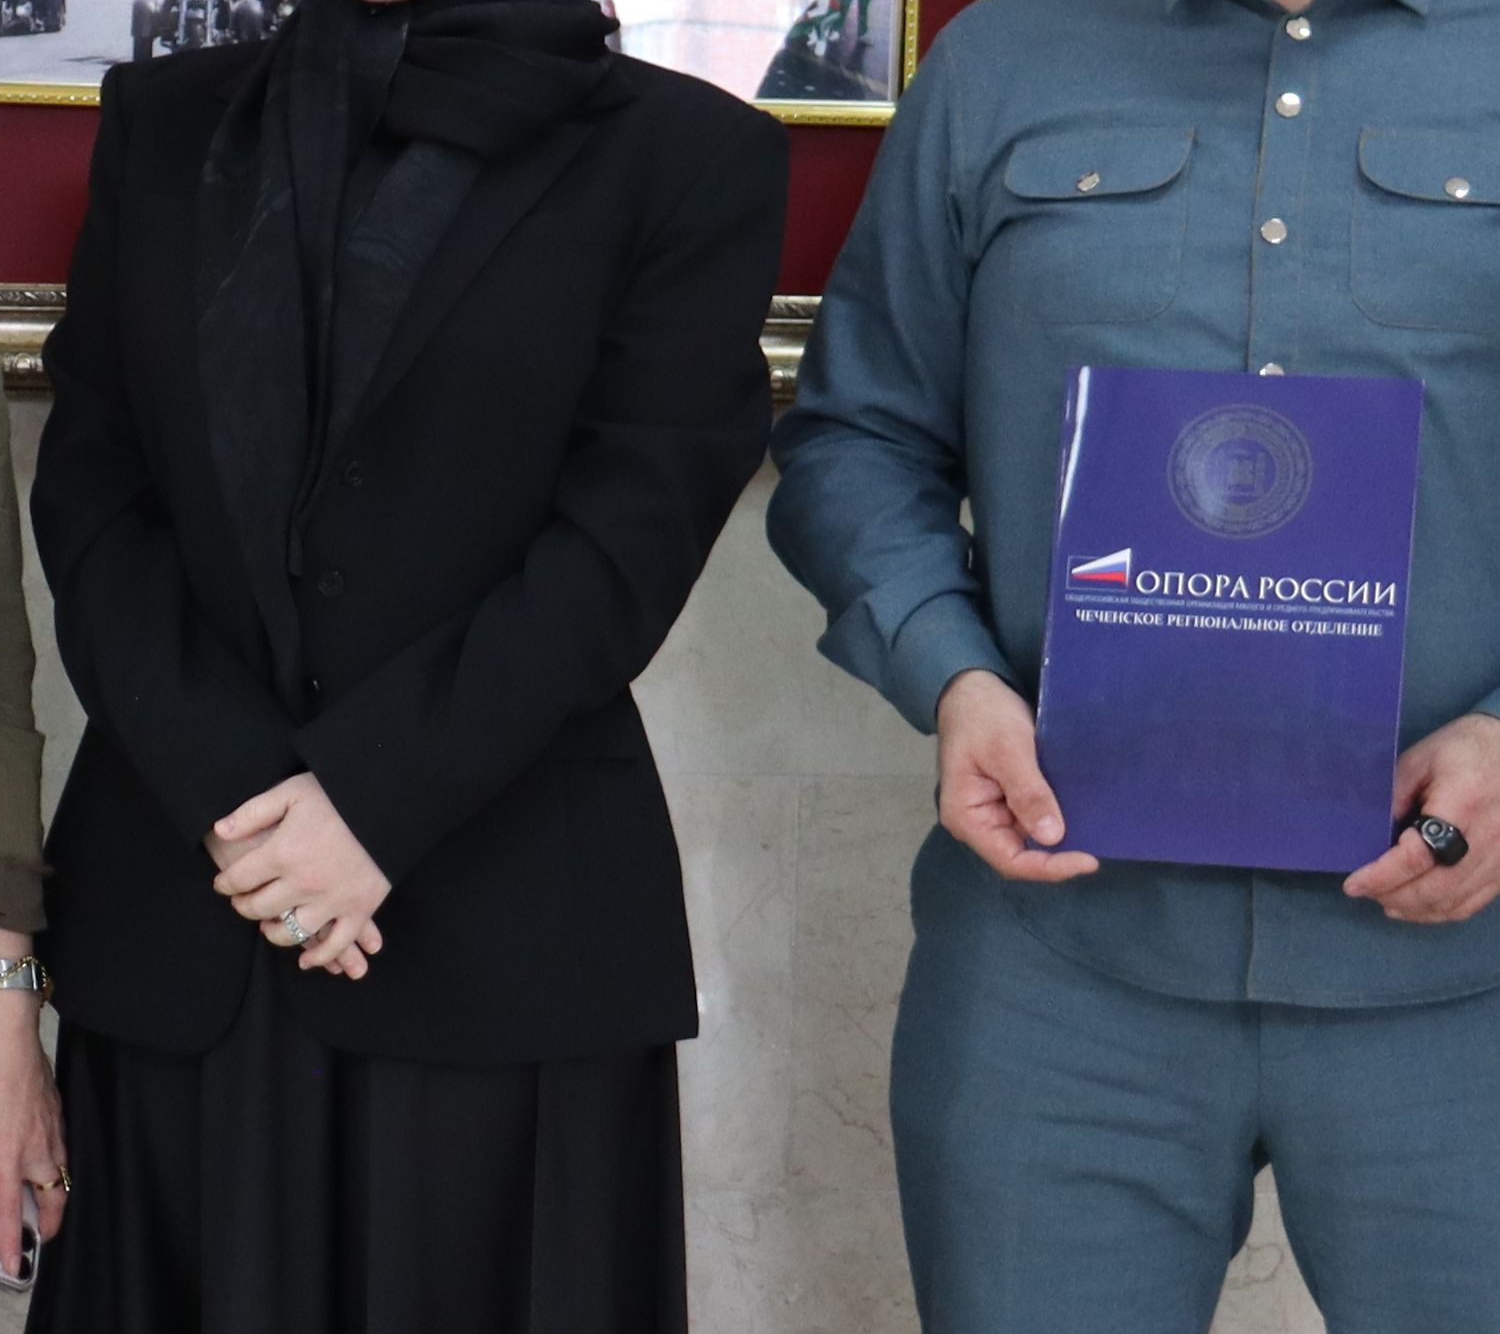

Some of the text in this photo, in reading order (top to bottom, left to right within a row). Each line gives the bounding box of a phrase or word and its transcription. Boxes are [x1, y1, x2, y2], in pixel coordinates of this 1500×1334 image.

[1136, 570, 1396, 606] ОПОРА РОССИИ
[1075, 608, 1383, 636] ЧЕЧЕНСКОЕ РЕГИОНАЛЬНОЕ ОТДЕЛЕНИЕ
